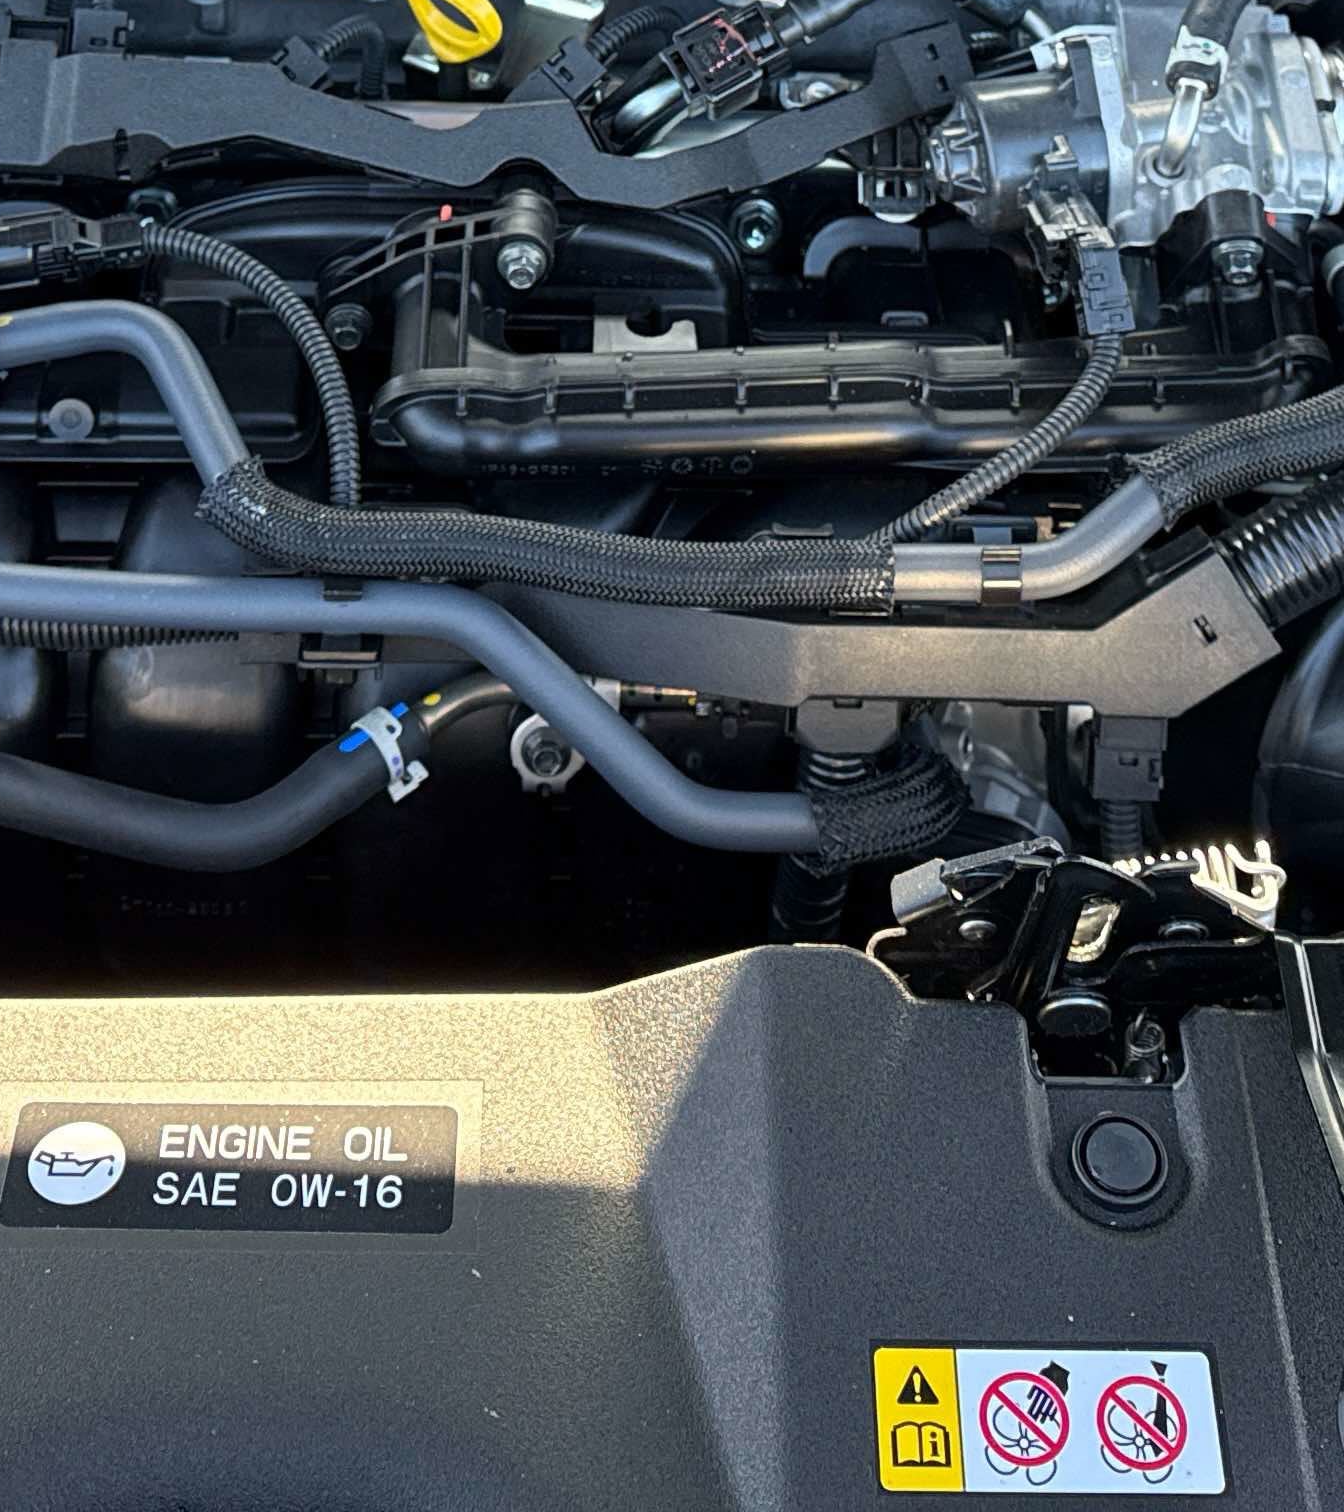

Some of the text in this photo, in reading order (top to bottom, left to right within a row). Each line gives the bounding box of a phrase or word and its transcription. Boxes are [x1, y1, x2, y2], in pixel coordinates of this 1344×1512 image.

[158, 1123, 408, 1162] ENGINE OIL
[153, 1172, 403, 1209] SAE 0W-16
